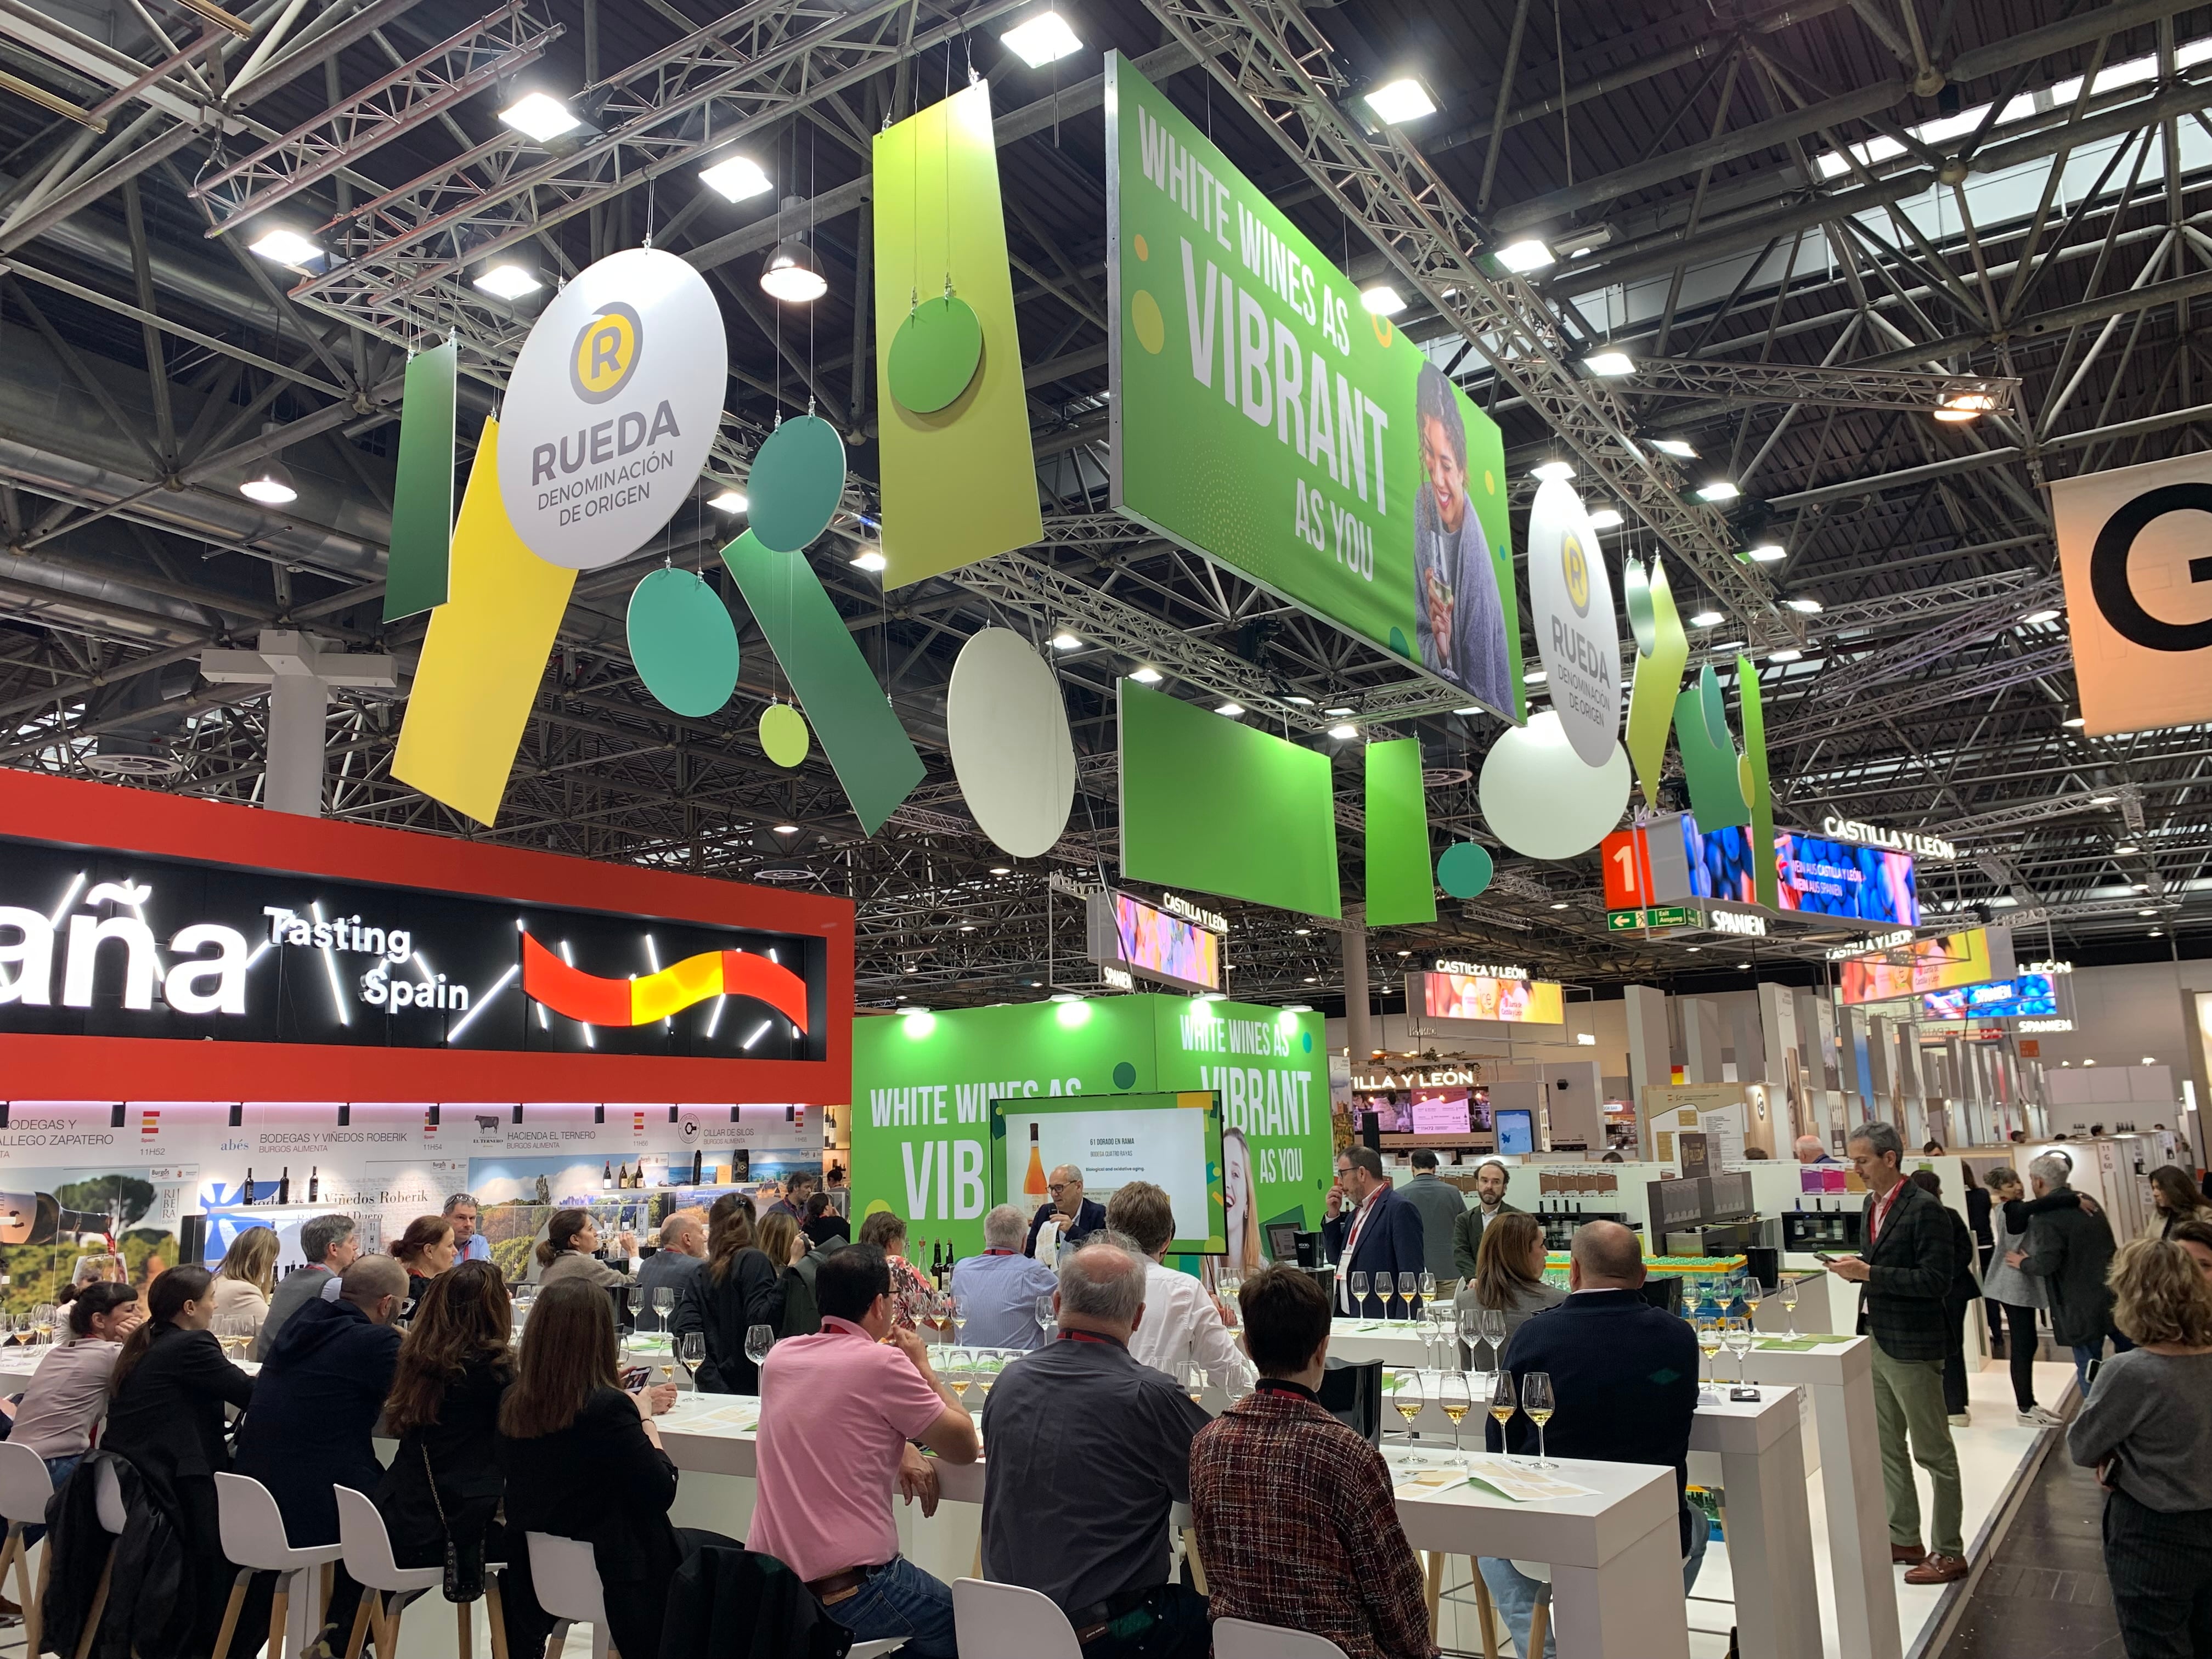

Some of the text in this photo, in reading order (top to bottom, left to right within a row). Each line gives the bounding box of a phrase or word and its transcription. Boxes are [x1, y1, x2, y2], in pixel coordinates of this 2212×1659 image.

[1138, 104, 1350, 357] WHITE WINES AS
[591, 326, 622, 380] R
[1180, 235, 1388, 516] VIBRANT
[532, 399, 681, 486] RUEDA
[538, 450, 674, 510] DENOMINACIÓN
[560, 482, 650, 527] DE ORIGEN
[1295, 477, 1374, 582] AS YOU
[1569, 546, 1584, 596] R
[1552, 614, 1610, 690] RUEDA
[1558, 664, 1610, 712] DENOMINACIÓN
[1570, 692, 1605, 728] DE ORIGEN
[1825, 817, 1956, 860] CASTILLA Y LEÓN
[1613, 845, 1635, 891] 1
[1805, 863, 1817, 875] AUS
[1816, 864, 1842, 879] CASTILLA
[1842, 867, 1847, 879] Y
[1794, 878, 1843, 897] WEIN AUS SPANIEN
[1163, 892, 1229, 933] CASTILLA Y LEÓN
[1659, 915, 1683, 924] Ausgang
[1711, 910, 1765, 936] SPANIEN
[0, 882, 247, 1015] aña
[263, 905, 411, 964] Tasting
[1876, 936, 1884, 950] Y
[1103, 966, 1133, 990] SPANIEN
[1436, 960, 1528, 979] CASTILLA Y LEÓN
[362, 968, 469, 1014] Spain
[1180, 1014, 1289, 1057] WHITE WINES AS
[2019, 1019, 2072, 1033] SPANIEN
[1351, 1068, 1474, 1090] ILLA Y LEÓN
[69, 1120, 77, 1130] Y
[870, 1085, 948, 1127] WHITE
[0, 1133, 114, 1146] LLEGO ZAPATERO
[221, 1139, 249, 1150] abés
[260, 1131, 408, 1143] BODEGAS Y VIÑEDOS ROBERIK
[507, 1131, 596, 1140] HACIENDA EL TERNERO
[151, 1169, 170, 1177] Burgos
[1260, 1148, 1303, 1184] AS YOU
[380, 1189, 428, 1204] Roberik
